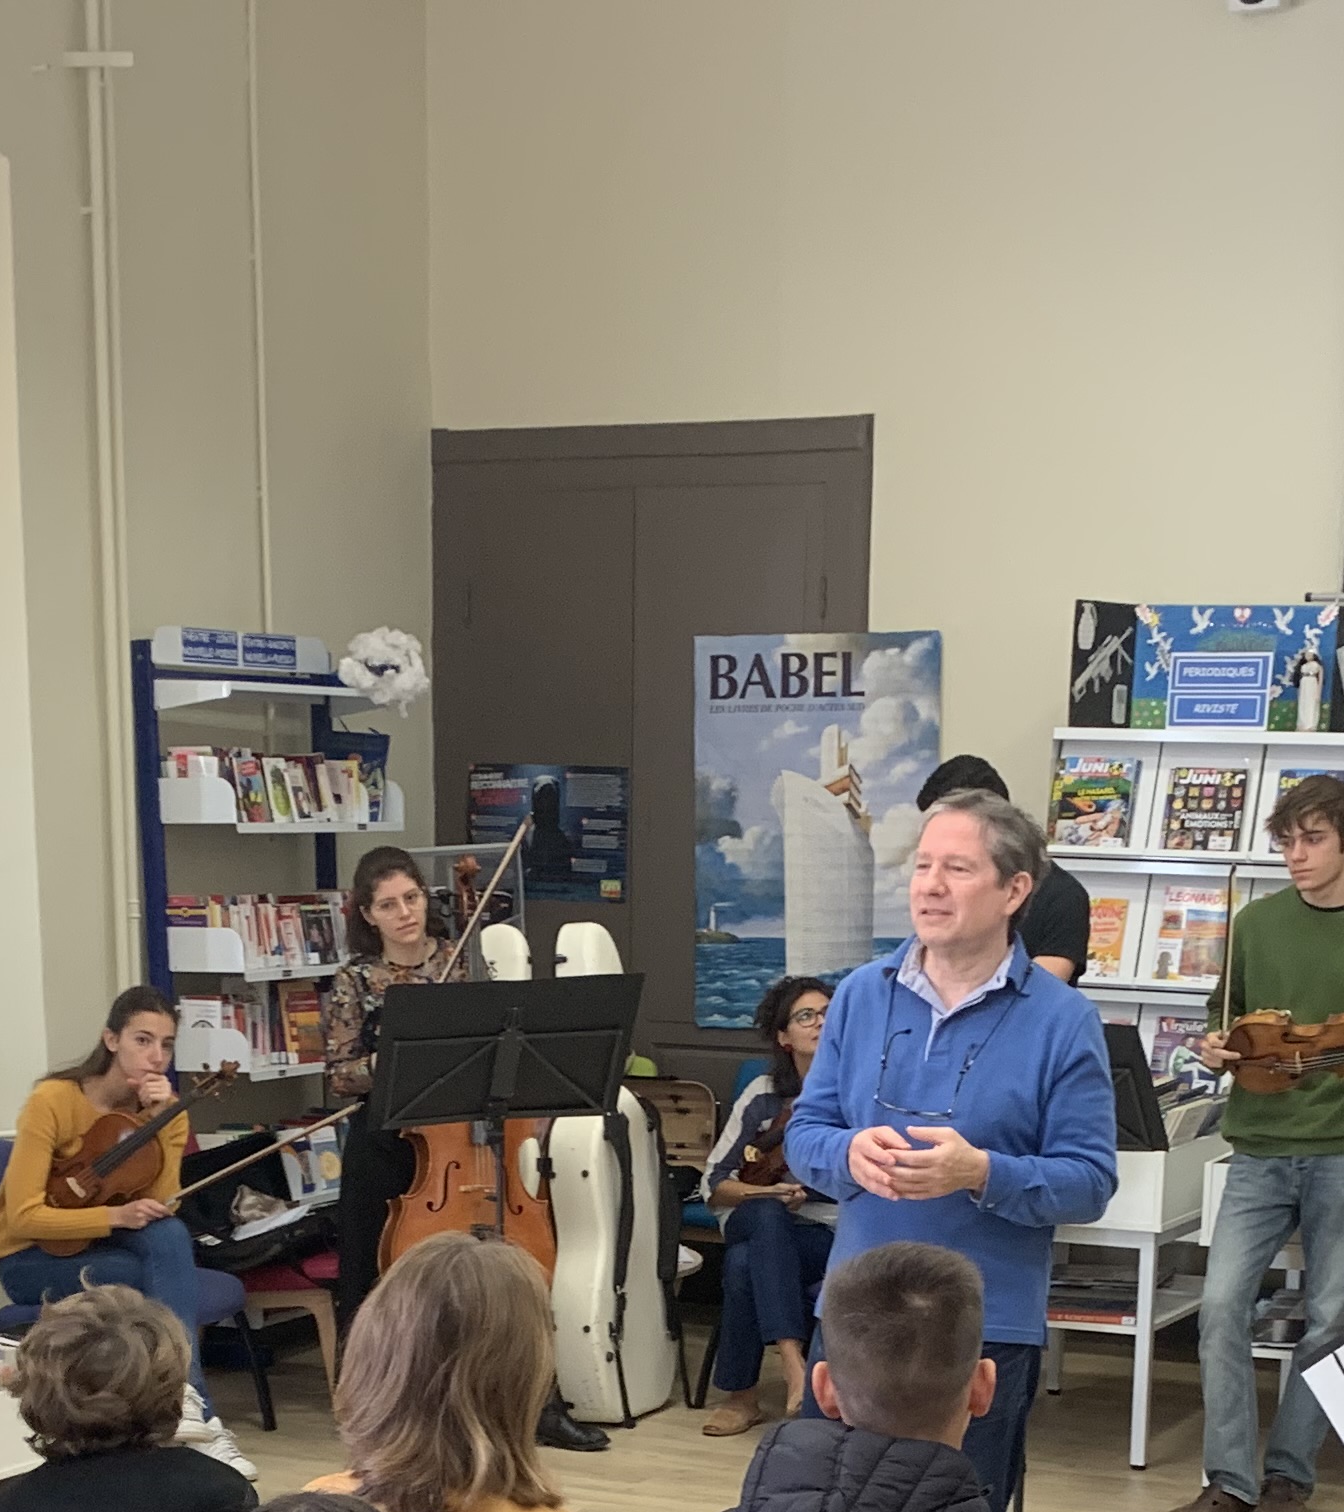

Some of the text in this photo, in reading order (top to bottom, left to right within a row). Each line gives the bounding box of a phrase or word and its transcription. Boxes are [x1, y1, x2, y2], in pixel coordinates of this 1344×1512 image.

[709, 652, 865, 700] BABEL
[709, 704, 725, 714] LES
[728, 704, 757, 714] LIVRES
[776, 703, 804, 713] POCHE
[848, 702, 866, 711] SUD
[1193, 703, 1239, 714] RIVISTE
